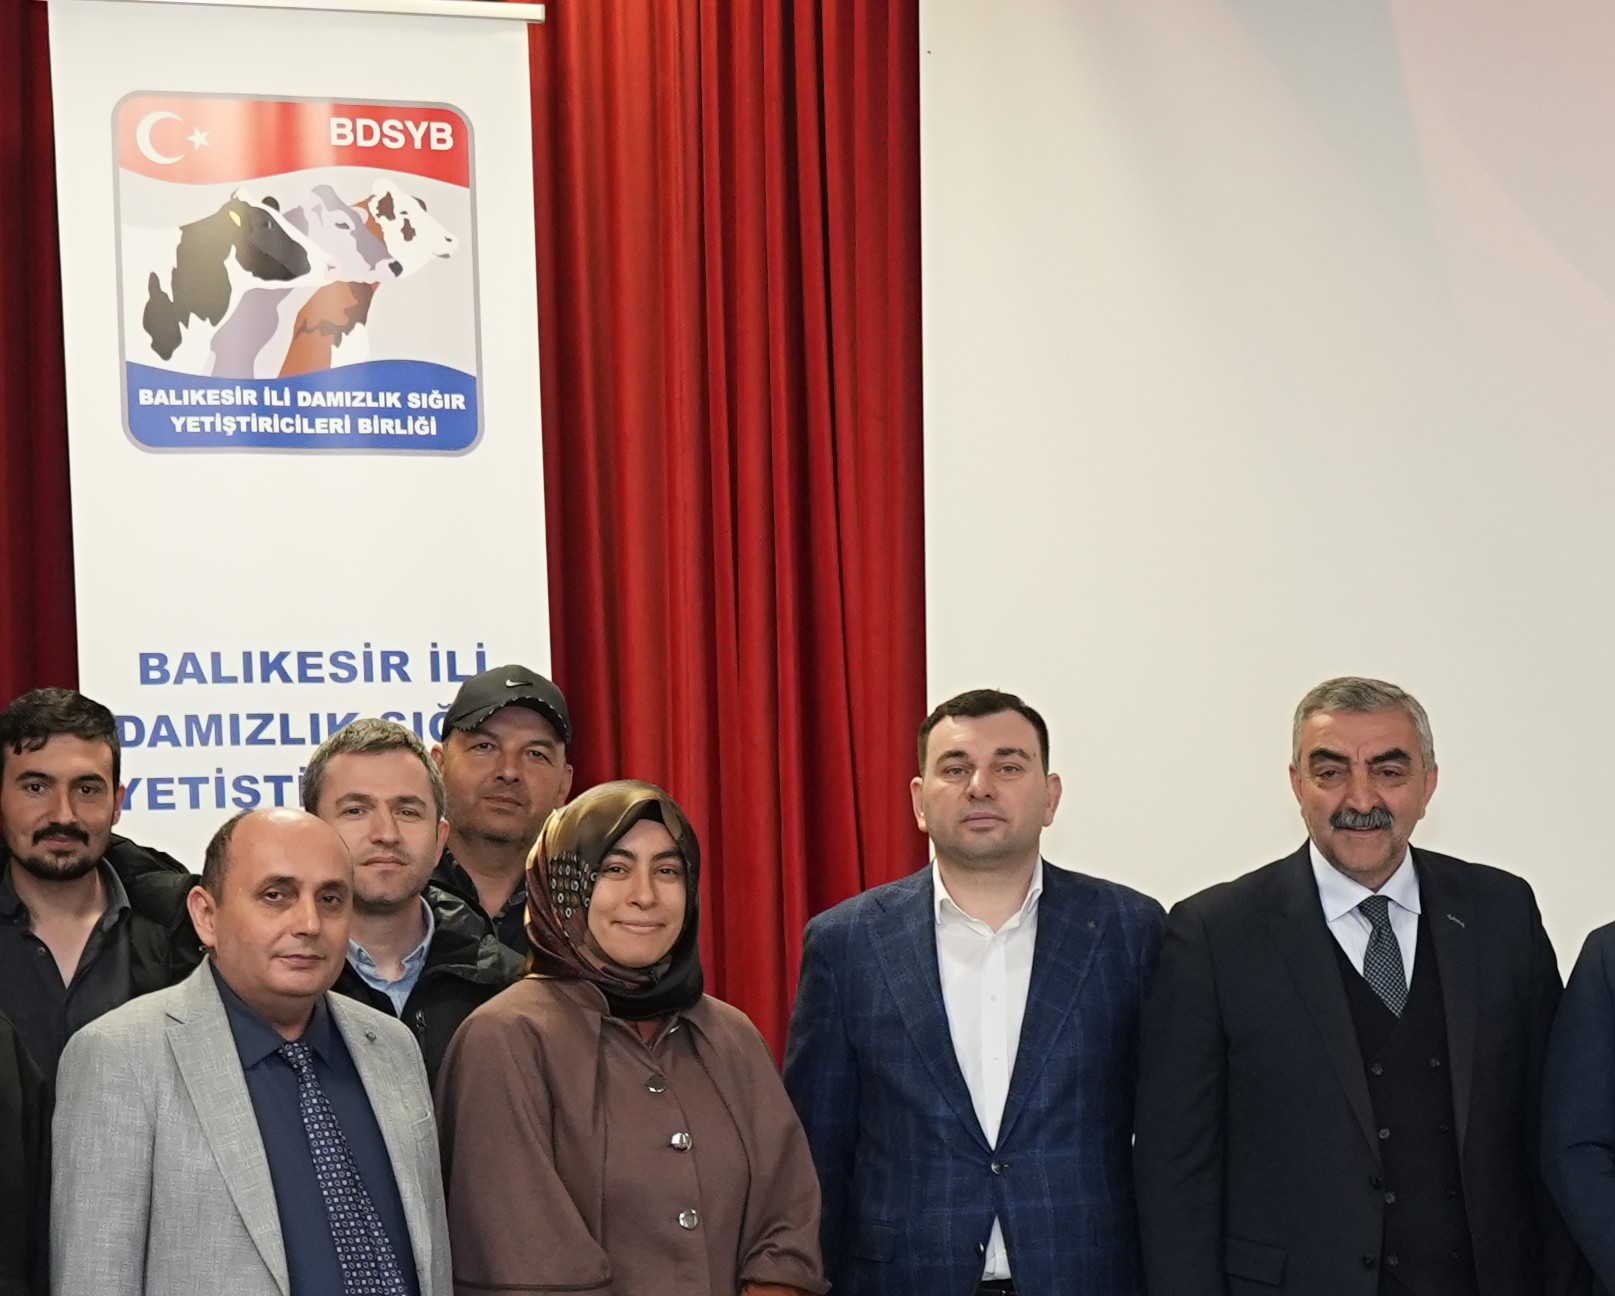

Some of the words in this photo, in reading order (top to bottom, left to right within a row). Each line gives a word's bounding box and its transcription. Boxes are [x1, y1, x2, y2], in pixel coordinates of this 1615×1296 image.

[329, 117, 454, 151] BDSYB
[138, 385, 258, 407] BALIKESİR
[263, 386, 291, 407] İLİ
[297, 391, 402, 409] DAMIZLIK
[407, 390, 466, 410] SIĞIR
[170, 412, 351, 437] YETİŞTİRİCİLERİ
[357, 415, 438, 436] BİRLİĞİ
[138, 642, 413, 686] BALIKESİR
